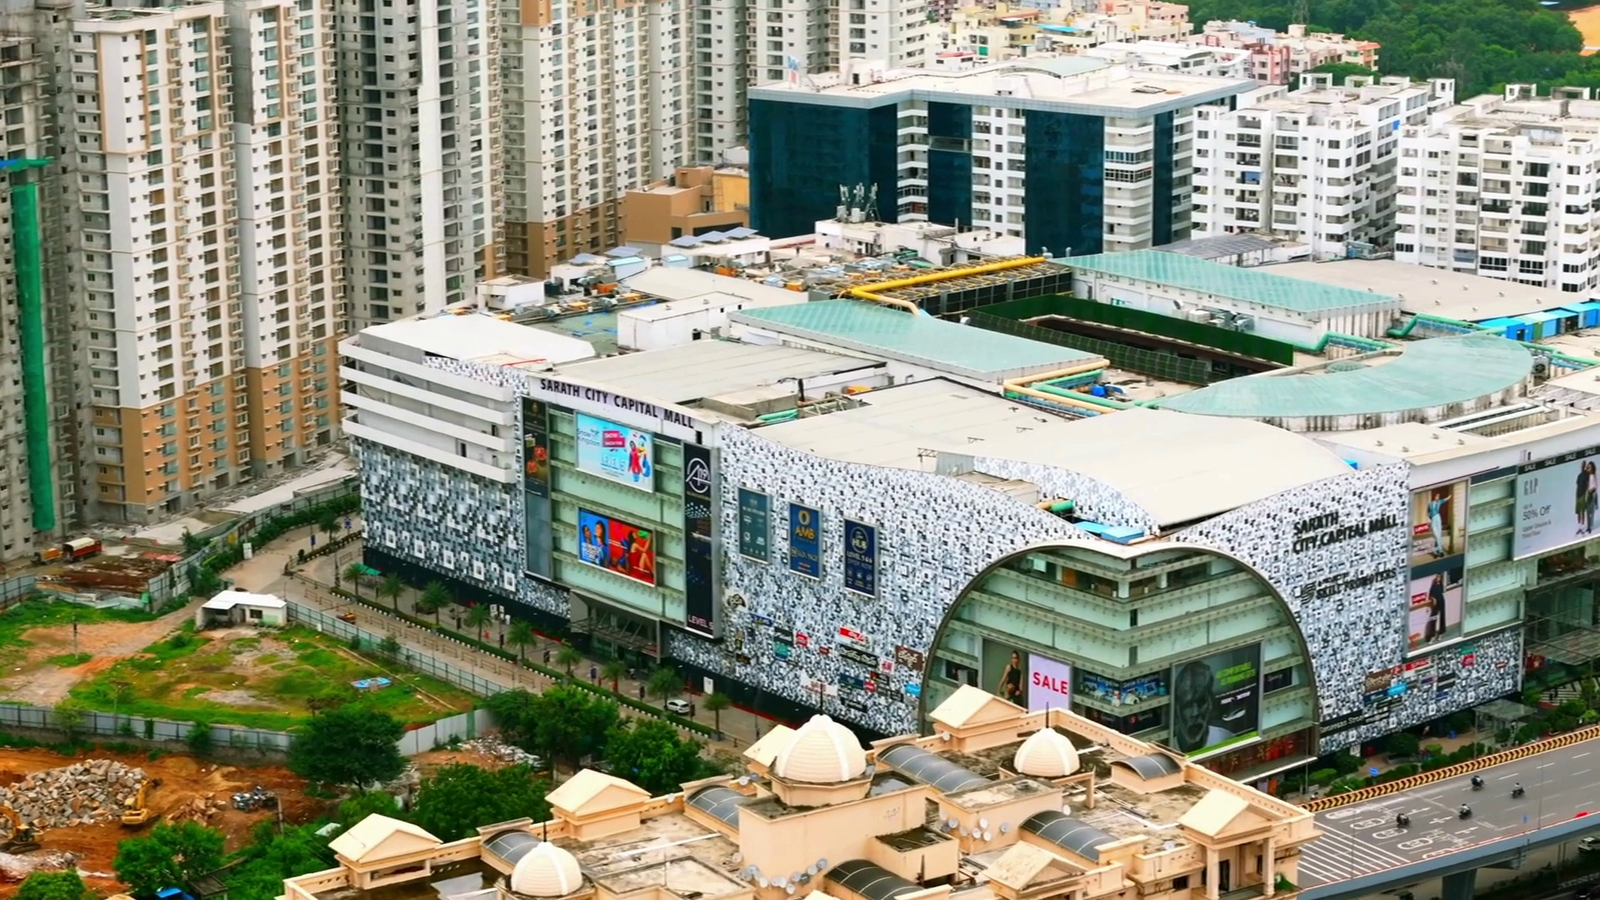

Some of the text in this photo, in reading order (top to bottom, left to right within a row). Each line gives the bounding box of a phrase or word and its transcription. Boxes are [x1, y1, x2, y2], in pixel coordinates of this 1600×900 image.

[540, 378, 694, 429] SARATH CITY CAPITAL MALL
[1523, 477, 1538, 496] GAP
[1523, 504, 1552, 521] 50% Off
[795, 525, 816, 540] AMB
[1293, 511, 1339, 536] SARATH
[1293, 513, 1398, 555] CITY CAPITAL MALL
[688, 614, 708, 628] LEVEL
[1033, 672, 1068, 695] SALE
